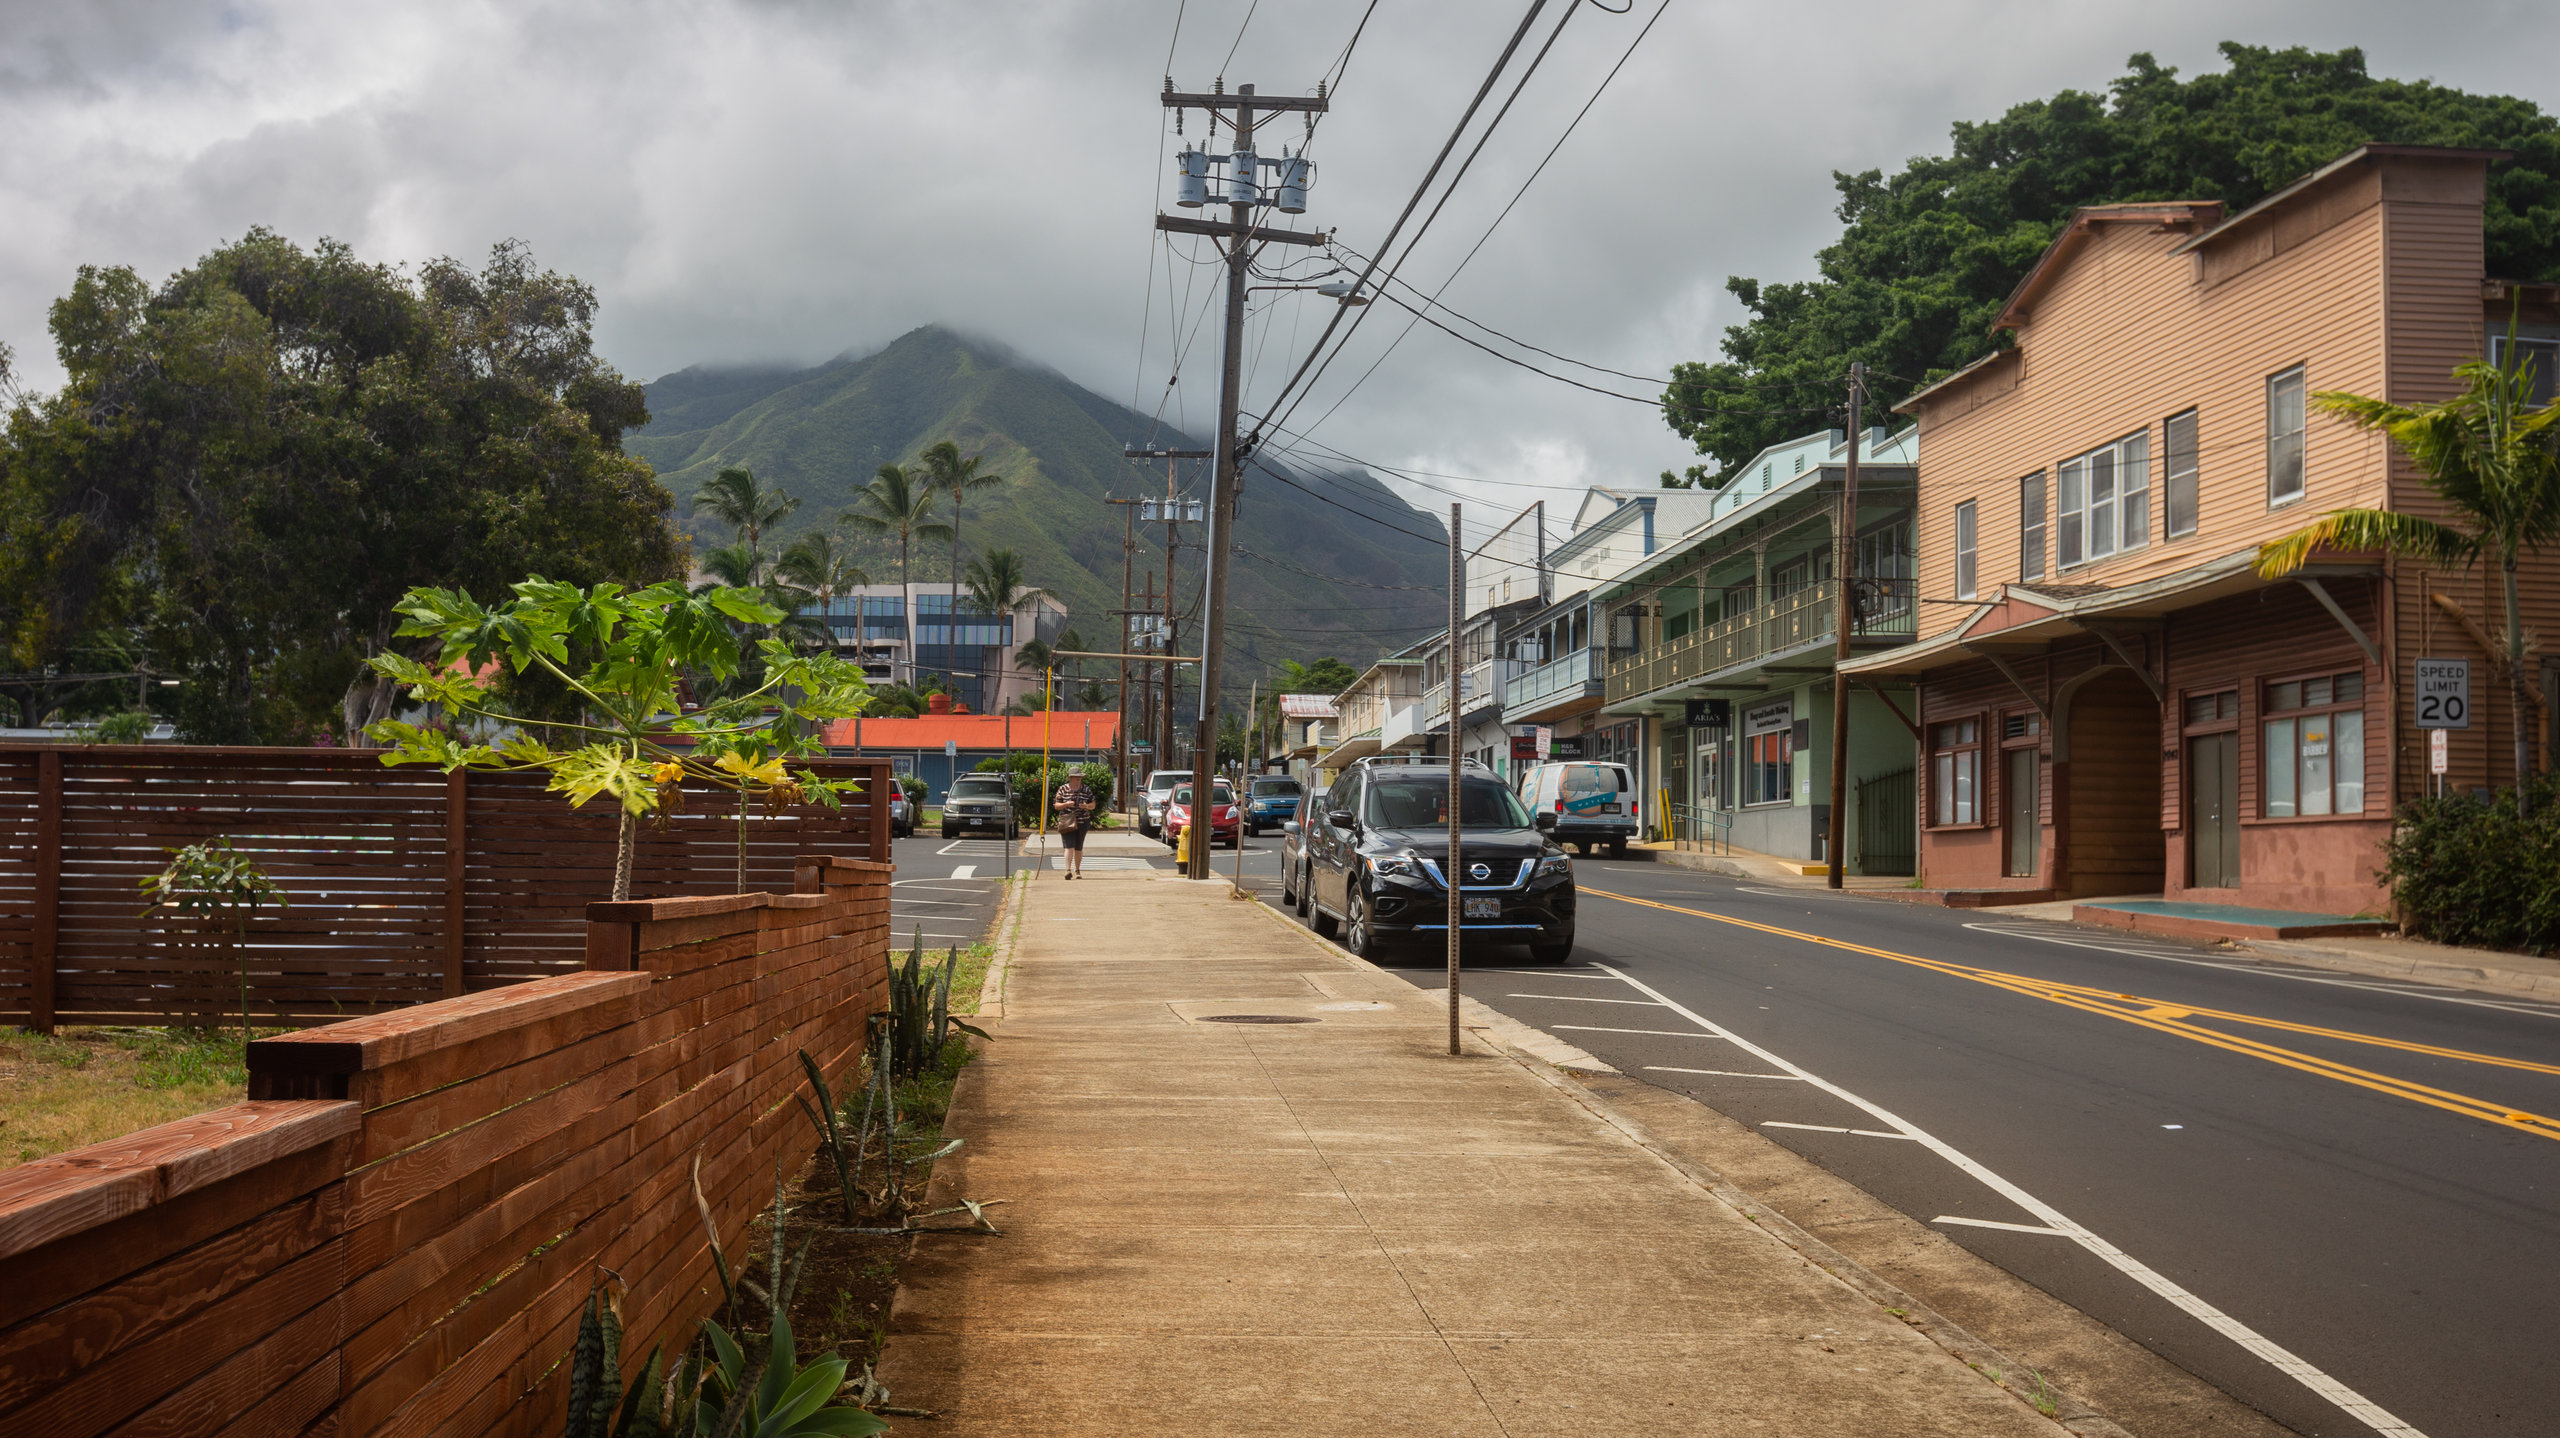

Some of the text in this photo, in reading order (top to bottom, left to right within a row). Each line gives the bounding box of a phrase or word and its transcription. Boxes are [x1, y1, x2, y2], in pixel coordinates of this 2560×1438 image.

[2420, 667, 2465, 678] SPEED
[2425, 681, 2460, 692] LIMIT
[2421, 695, 2464, 721] 20
[1694, 713, 1721, 722] ARIA'S
